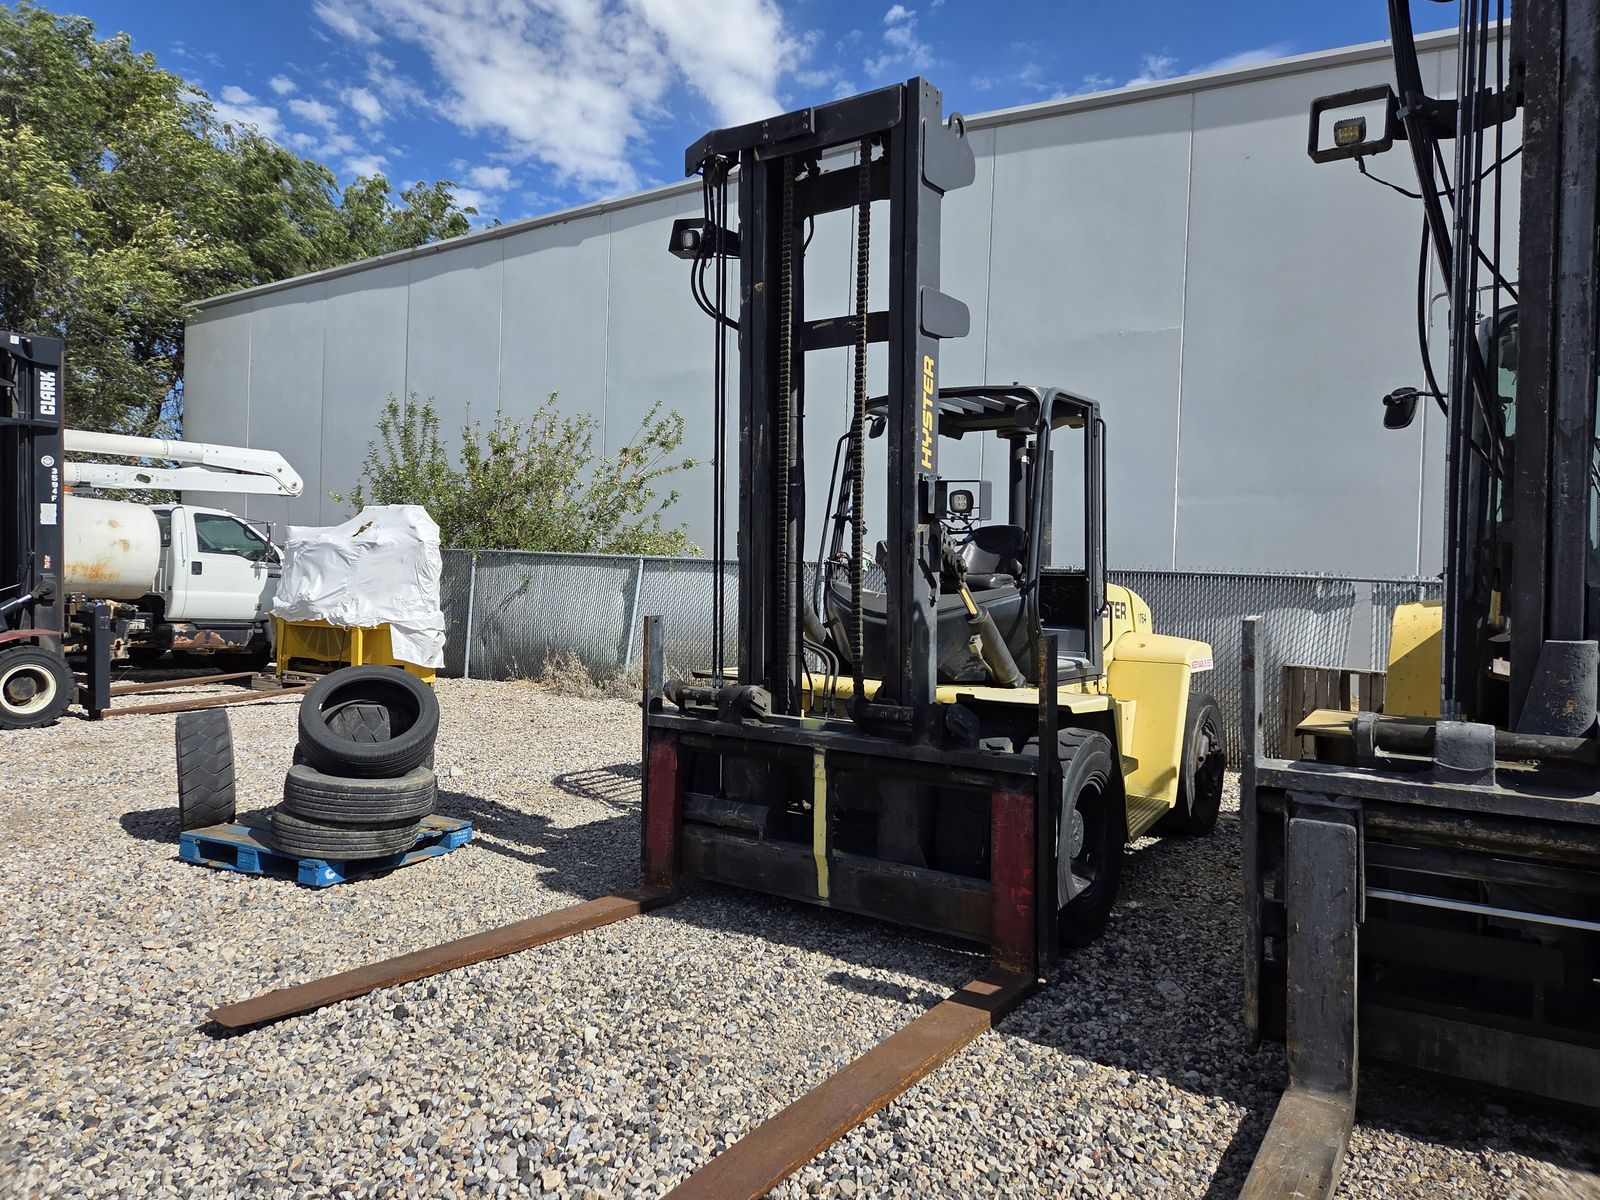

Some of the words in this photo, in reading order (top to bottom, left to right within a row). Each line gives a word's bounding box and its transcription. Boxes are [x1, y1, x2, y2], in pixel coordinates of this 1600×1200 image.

[40, 370, 56, 415] CLARK
[921, 355, 935, 469] HYSTER
[51, 467, 59, 502] 3594F
